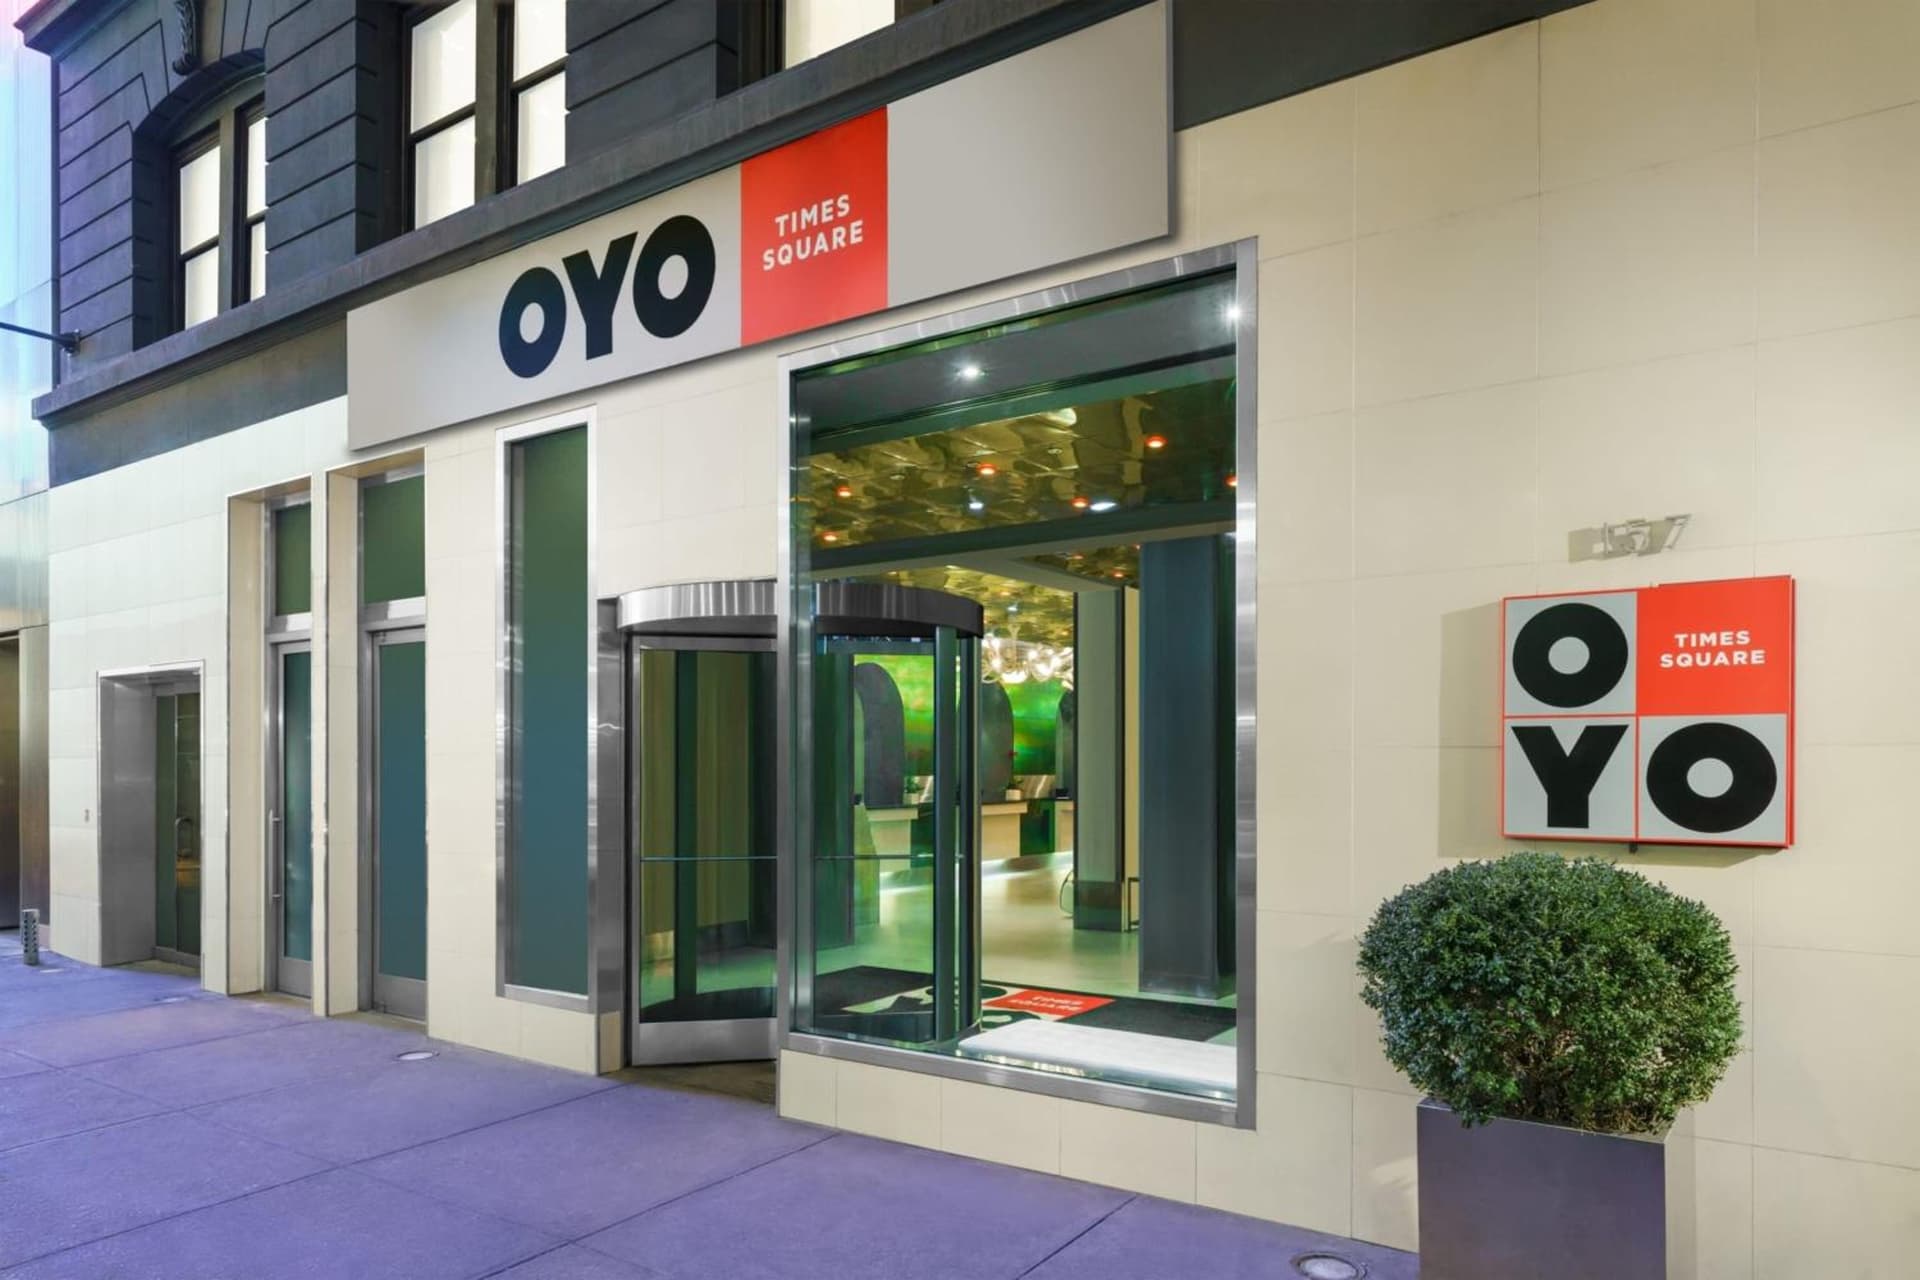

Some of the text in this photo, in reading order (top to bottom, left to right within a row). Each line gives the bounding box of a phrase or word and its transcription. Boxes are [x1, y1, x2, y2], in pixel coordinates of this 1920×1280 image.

[774, 194, 851, 237] TIMES
[762, 219, 864, 271] SQUARE
[498, 214, 716, 379] OYO
[1659, 649, 1765, 668] SQUARE
[1674, 630, 1751, 648] TIMES
